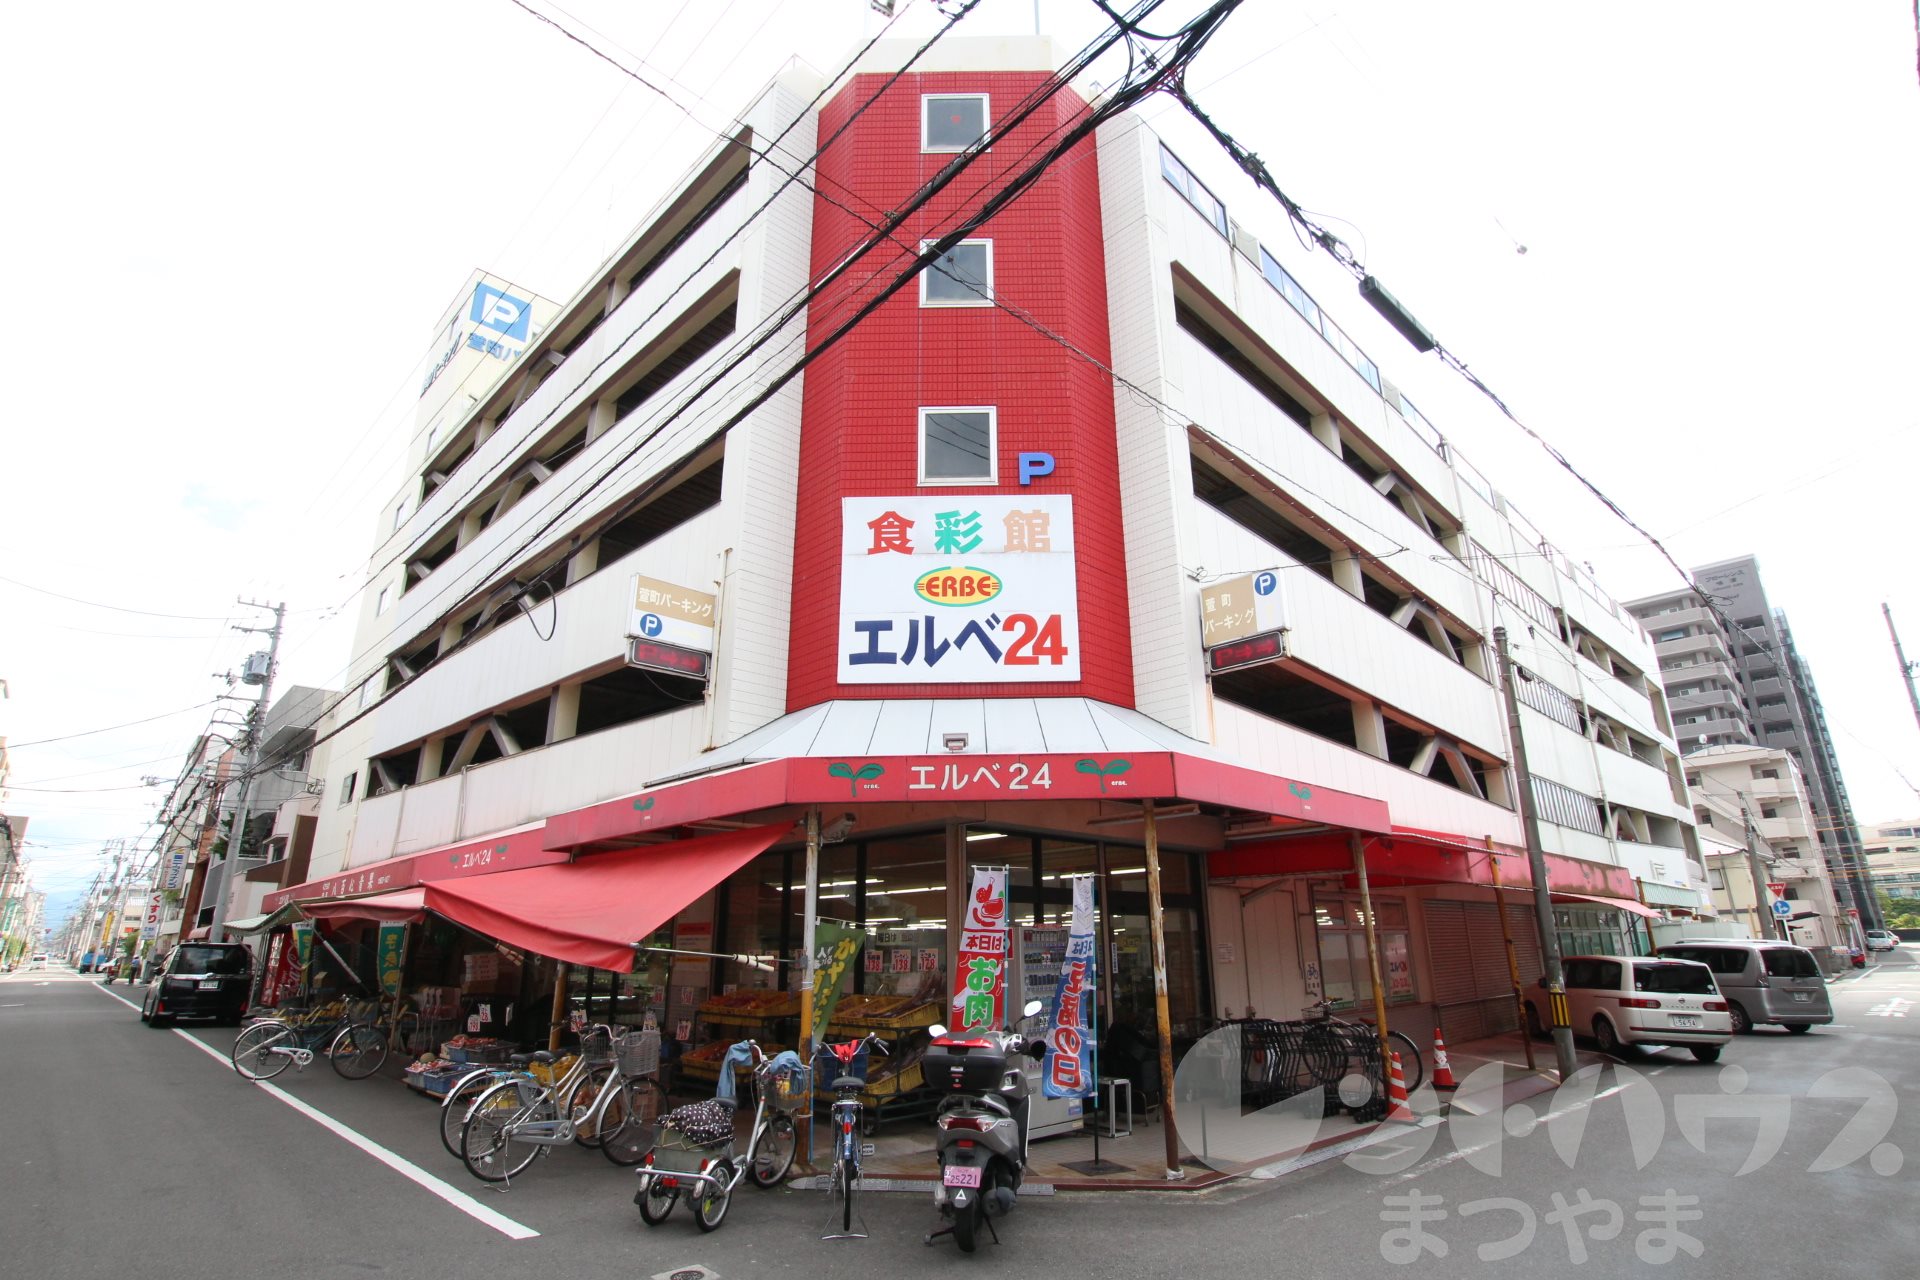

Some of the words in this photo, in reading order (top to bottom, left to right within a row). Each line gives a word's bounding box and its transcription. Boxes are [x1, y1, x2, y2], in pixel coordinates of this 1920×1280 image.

[1018, 452, 1056, 486] P
[866, 509, 1052, 555] 食彩館
[925, 575, 993, 598] ERBE
[1259, 575, 1271, 595] P
[637, 586, 714, 618] 萱町パーキング
[644, 615, 658, 634] P
[1204, 607, 1255, 635] パーキング
[848, 612, 1068, 668] エルベ24
[909, 762, 1052, 791] エルベ24
[147, 895, 162, 924] くすり
[965, 934, 1003, 952] 本日は
[964, 956, 999, 1033] お肉
[950, 1173, 977, 1186] 25221
